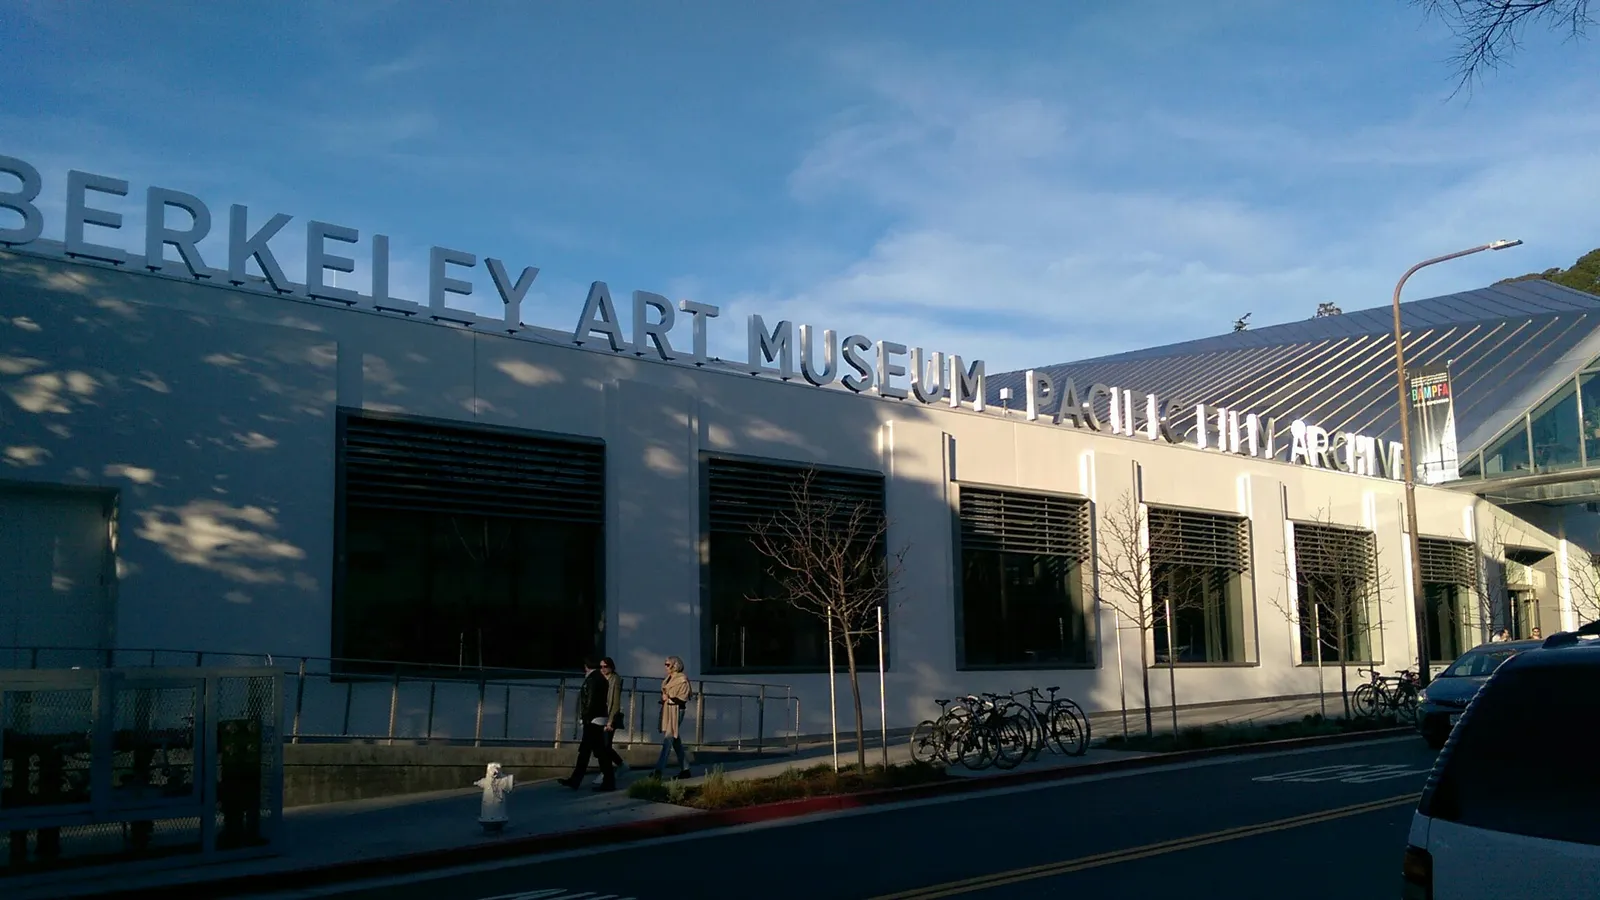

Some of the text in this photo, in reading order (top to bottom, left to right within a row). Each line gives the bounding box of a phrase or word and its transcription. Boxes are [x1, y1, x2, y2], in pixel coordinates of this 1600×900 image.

[0, 154, 540, 334] BERKELEY
[572, 280, 720, 367] ART
[747, 313, 987, 412] MUSEUM
[1026, 369, 1186, 444] PACIFIC
[1197, 403, 1276, 460] FILM
[1411, 382, 1449, 402] BAMPFA
